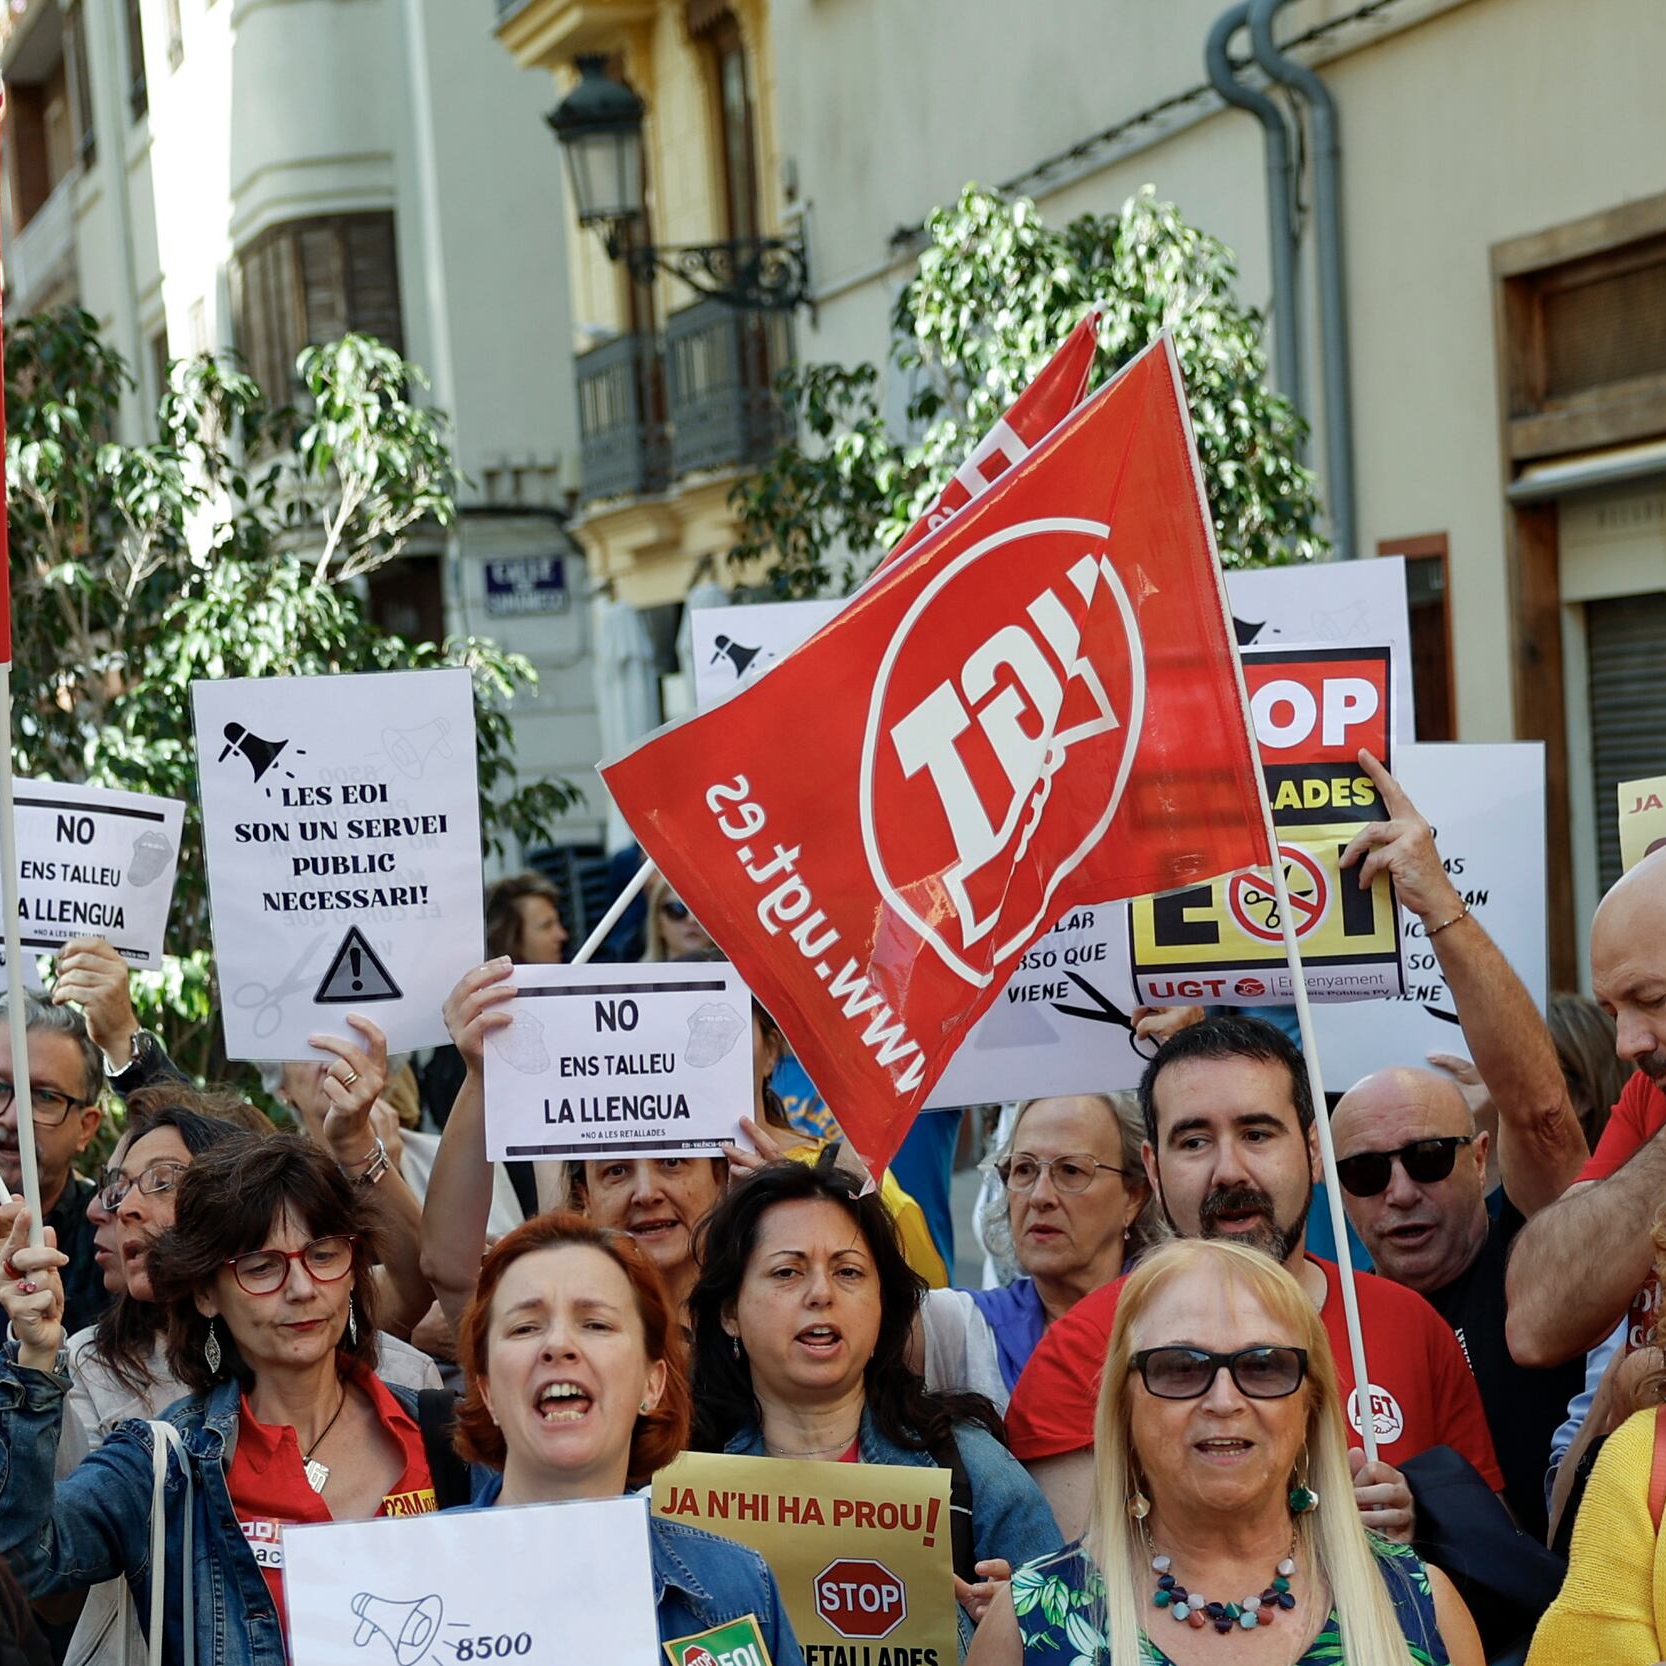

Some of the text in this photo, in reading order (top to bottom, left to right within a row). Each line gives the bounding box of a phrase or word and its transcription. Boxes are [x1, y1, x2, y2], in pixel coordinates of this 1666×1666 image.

[281, 783, 389, 807] LES EOI
[1628, 793, 1664, 815] JA
[56, 815, 96, 845] NO
[234, 814, 448, 843] SON UN SERVEI
[20, 861, 121, 888] ENS TALLEU
[292, 853, 396, 876] PUBLIC
[262, 885, 429, 912] NECESSARI!
[35, 898, 125, 929] LLENGUA
[1064, 943, 1108, 966] QUE
[1007, 981, 1070, 1004] VIENE
[1147, 978, 1227, 1000] UGT
[595, 999, 640, 1032] NO
[560, 1053, 675, 1077] ENS TALLEU
[544, 1094, 691, 1124] LA LLENGUA
[660, 1487, 941, 1548] JA N'HI HA PROU!
[821, 1582, 900, 1613] STOP
[455, 1631, 533, 1662] 8500
